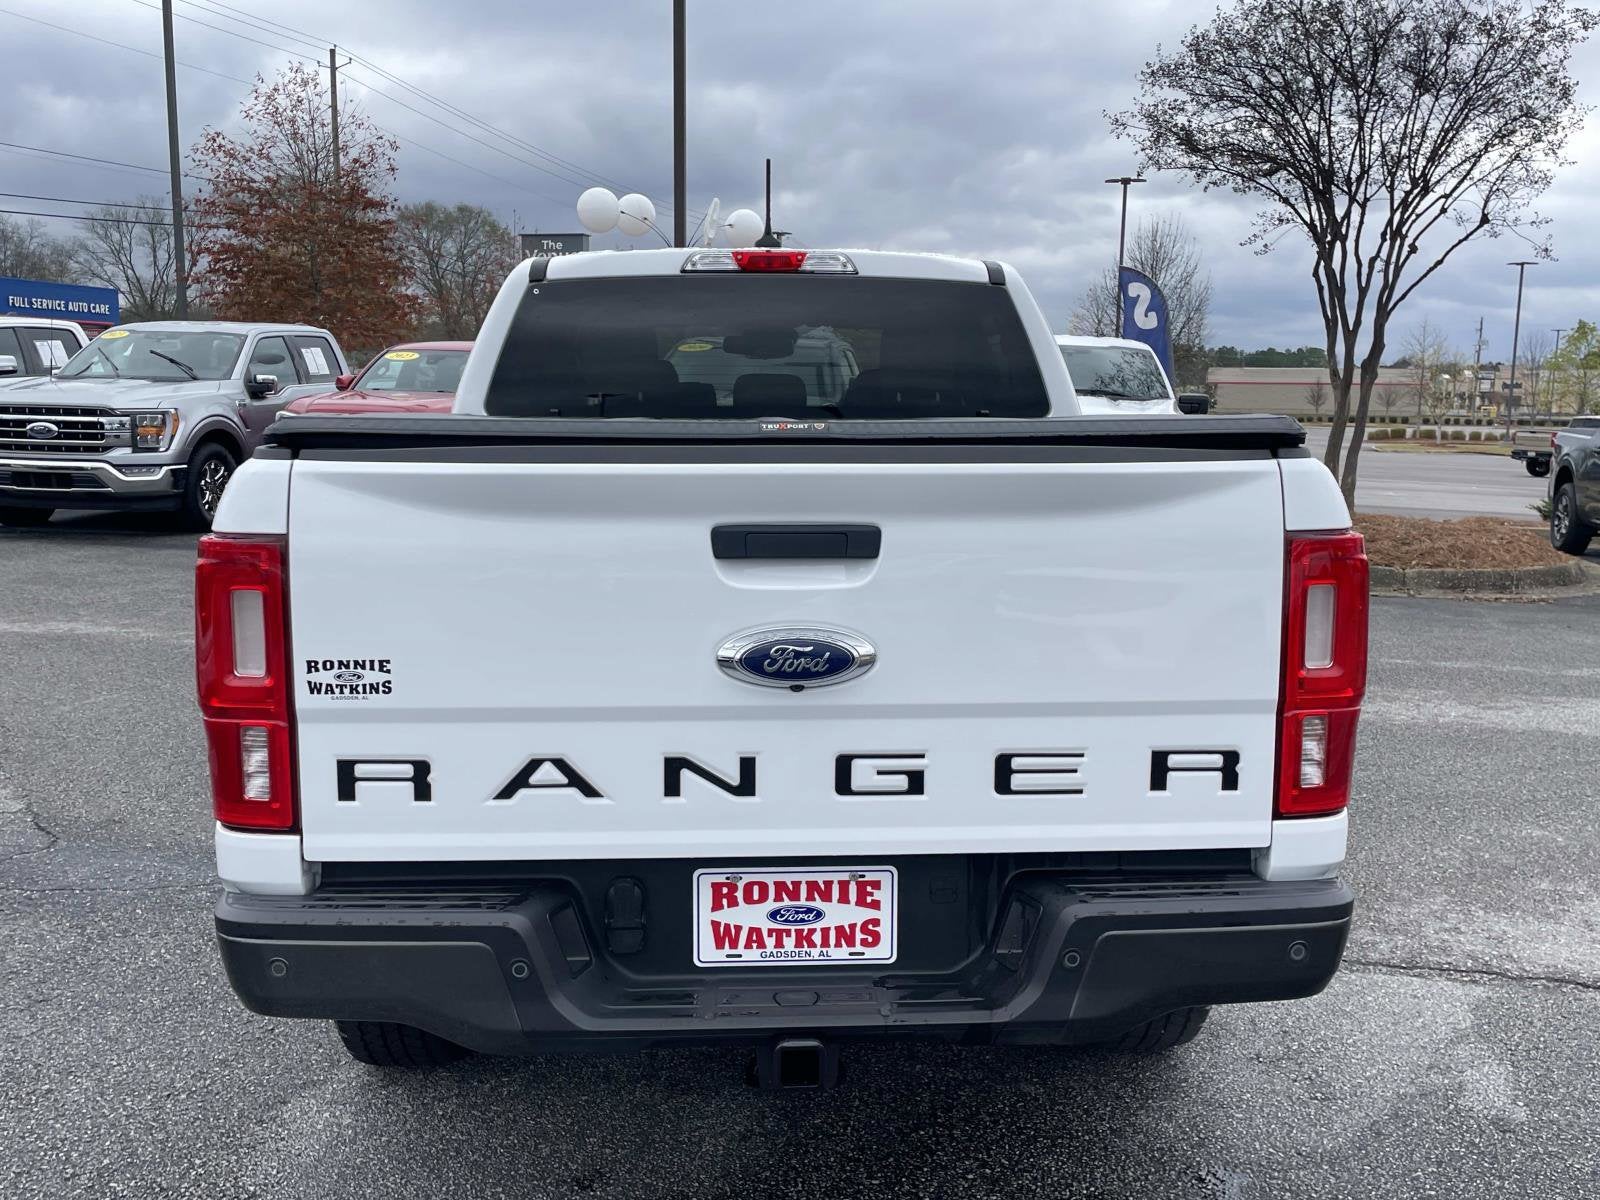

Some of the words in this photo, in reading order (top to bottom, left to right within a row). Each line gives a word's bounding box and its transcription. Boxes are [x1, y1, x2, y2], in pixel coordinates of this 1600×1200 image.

[541, 240, 563, 250] The
[8, 296, 30, 308] FULL
[31, 298, 66, 311] SERVICE
[67, 301, 89, 313] AUTO
[90, 303, 111, 315] CARE
[305, 659, 391, 674] RONNIE
[763, 645, 831, 673] Ford
[306, 680, 392, 695] WATKINS
[336, 749, 1241, 802] RANGER
[710, 879, 882, 913] RONNIE
[775, 907, 817, 922] Ford
[710, 917, 881, 950] WATKINS
[759, 950, 815, 959] GADSDEN,
[818, 950, 832, 958] AL
